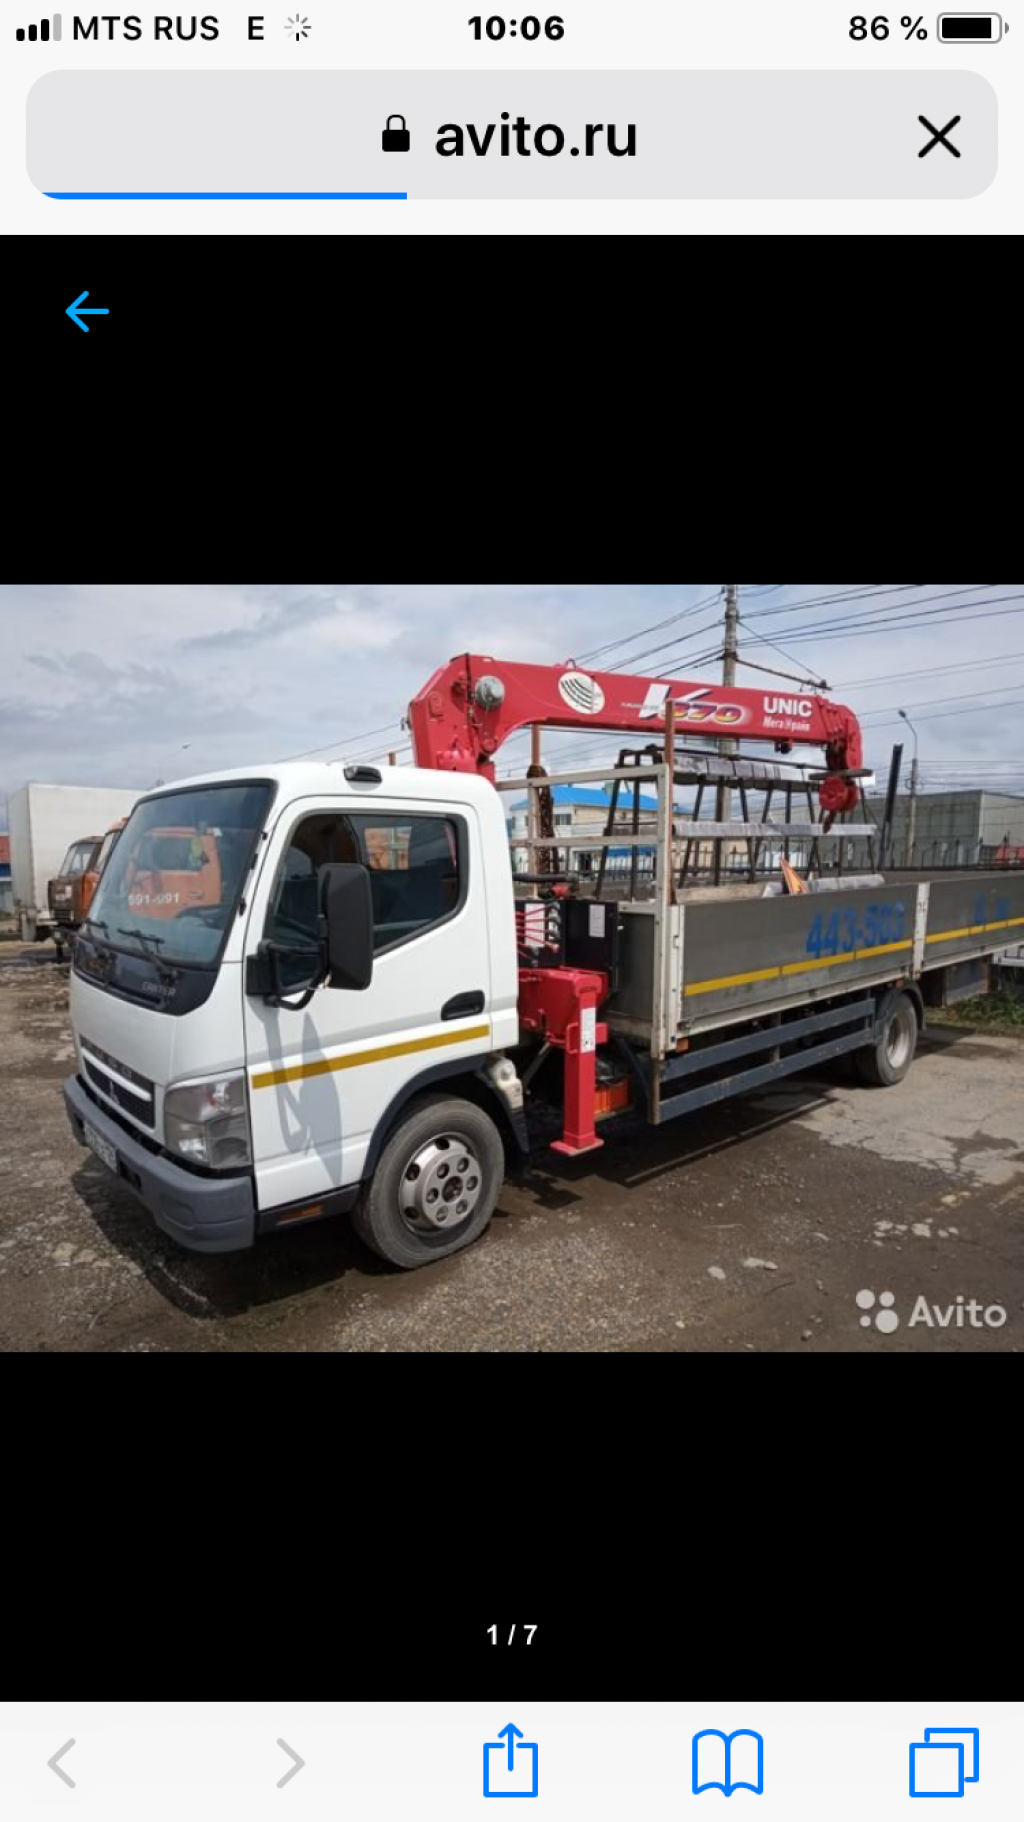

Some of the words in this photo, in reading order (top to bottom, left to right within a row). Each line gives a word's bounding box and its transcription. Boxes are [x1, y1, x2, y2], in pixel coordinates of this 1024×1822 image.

[73, 15, 142, 41] MTS
[154, 15, 219, 41] RUS
[248, 15, 265, 41] E
[468, 15, 565, 41] 10:06
[848, 15, 890, 41] 86
[900, 15, 928, 41] %
[435, 111, 637, 157] avito.ru
[763, 696, 812, 718] UNIC
[486, 1623, 498, 1645] 1
[507, 1623, 517, 1646] /
[523, 1624, 538, 1645] 7
